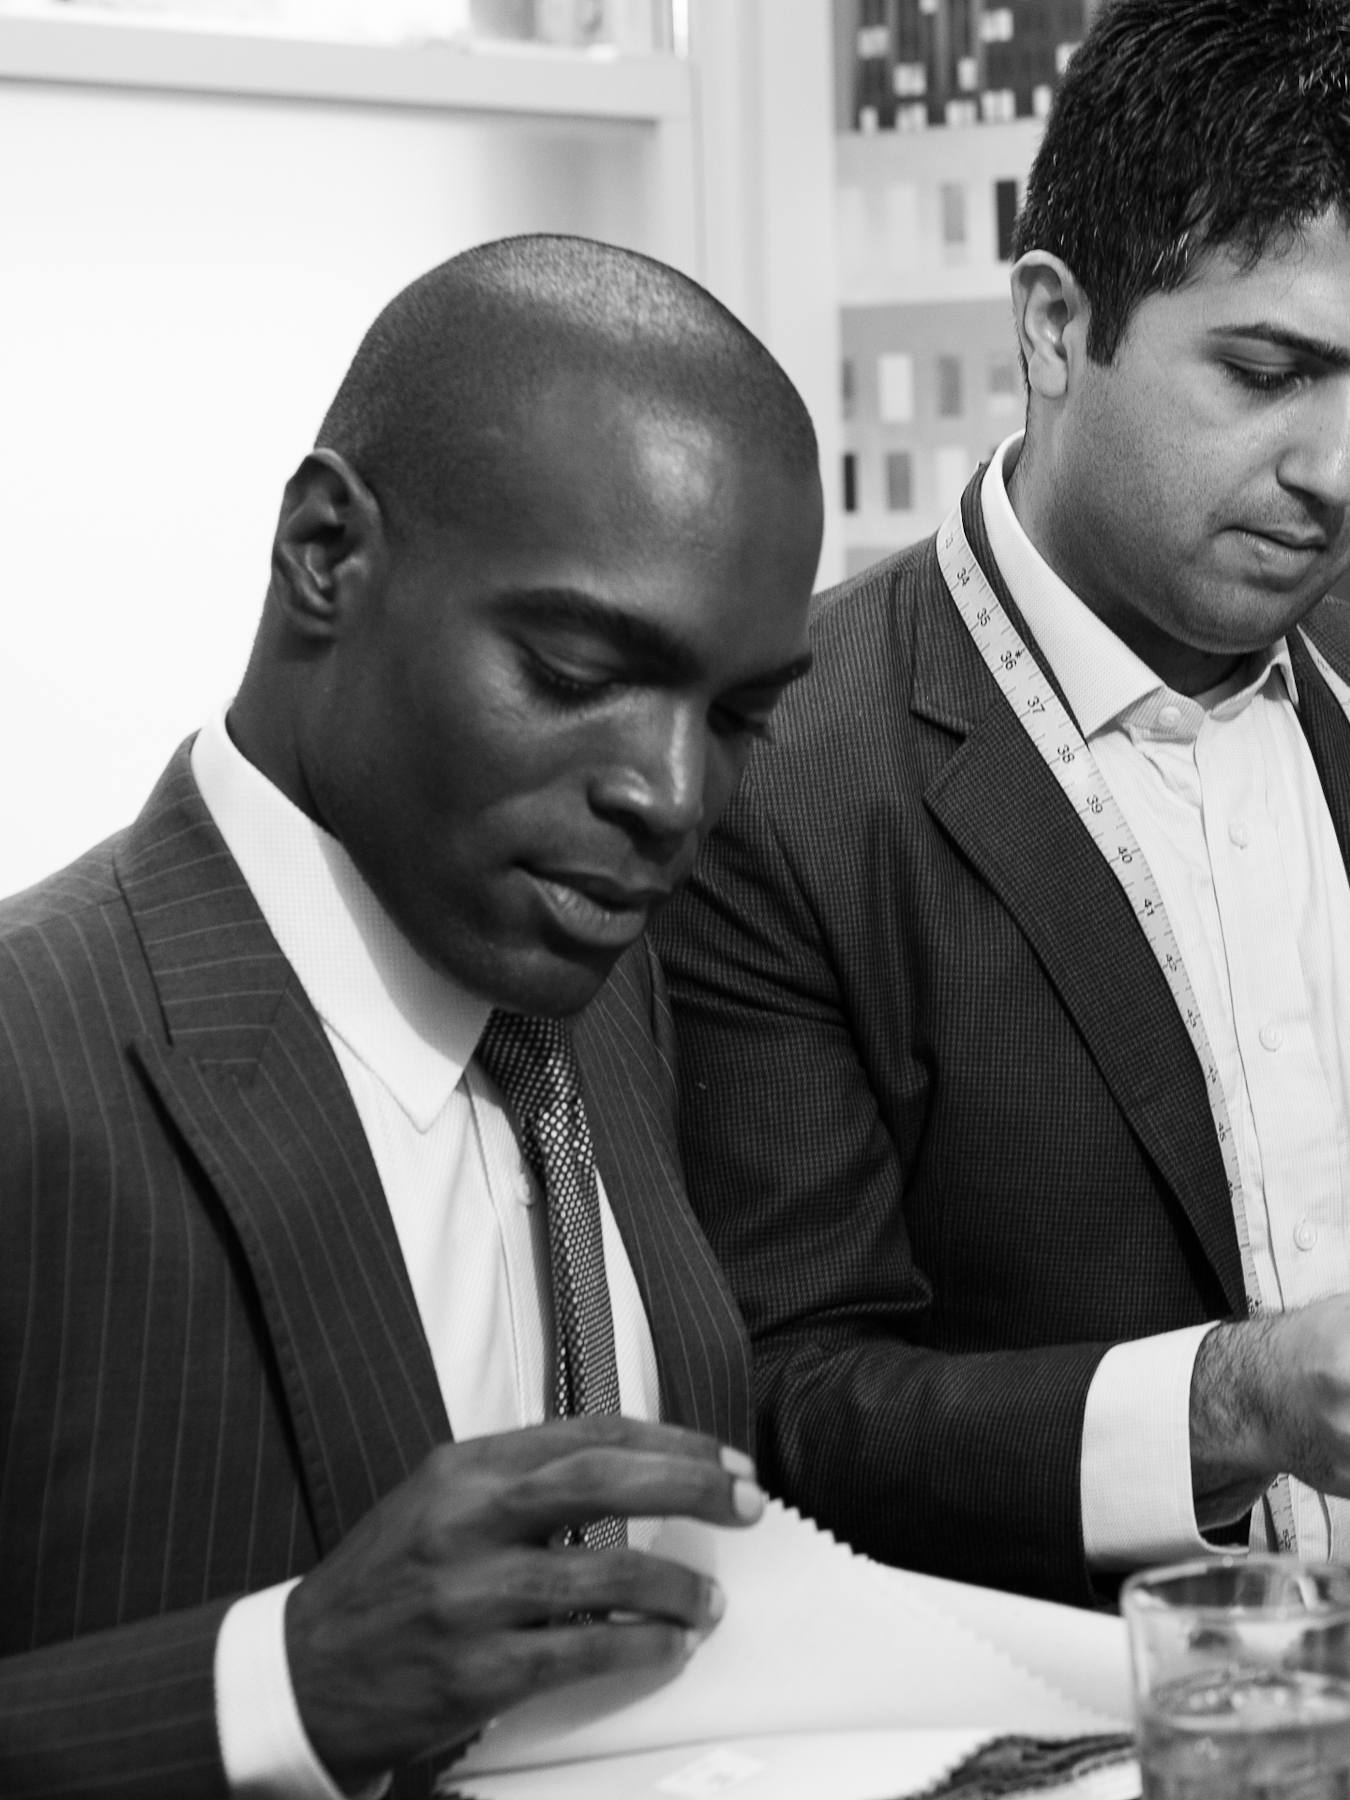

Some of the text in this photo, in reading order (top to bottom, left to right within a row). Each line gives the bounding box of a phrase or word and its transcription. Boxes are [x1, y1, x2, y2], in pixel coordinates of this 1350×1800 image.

[957, 567, 970, 587] 34
[977, 608, 991, 627] 35
[1027, 695, 1045, 714] 37
[1057, 744, 1075, 763] 38
[1087, 794, 1103, 814] 39
[1118, 846, 1132, 864] 40
[1144, 898, 1155, 916] 41
